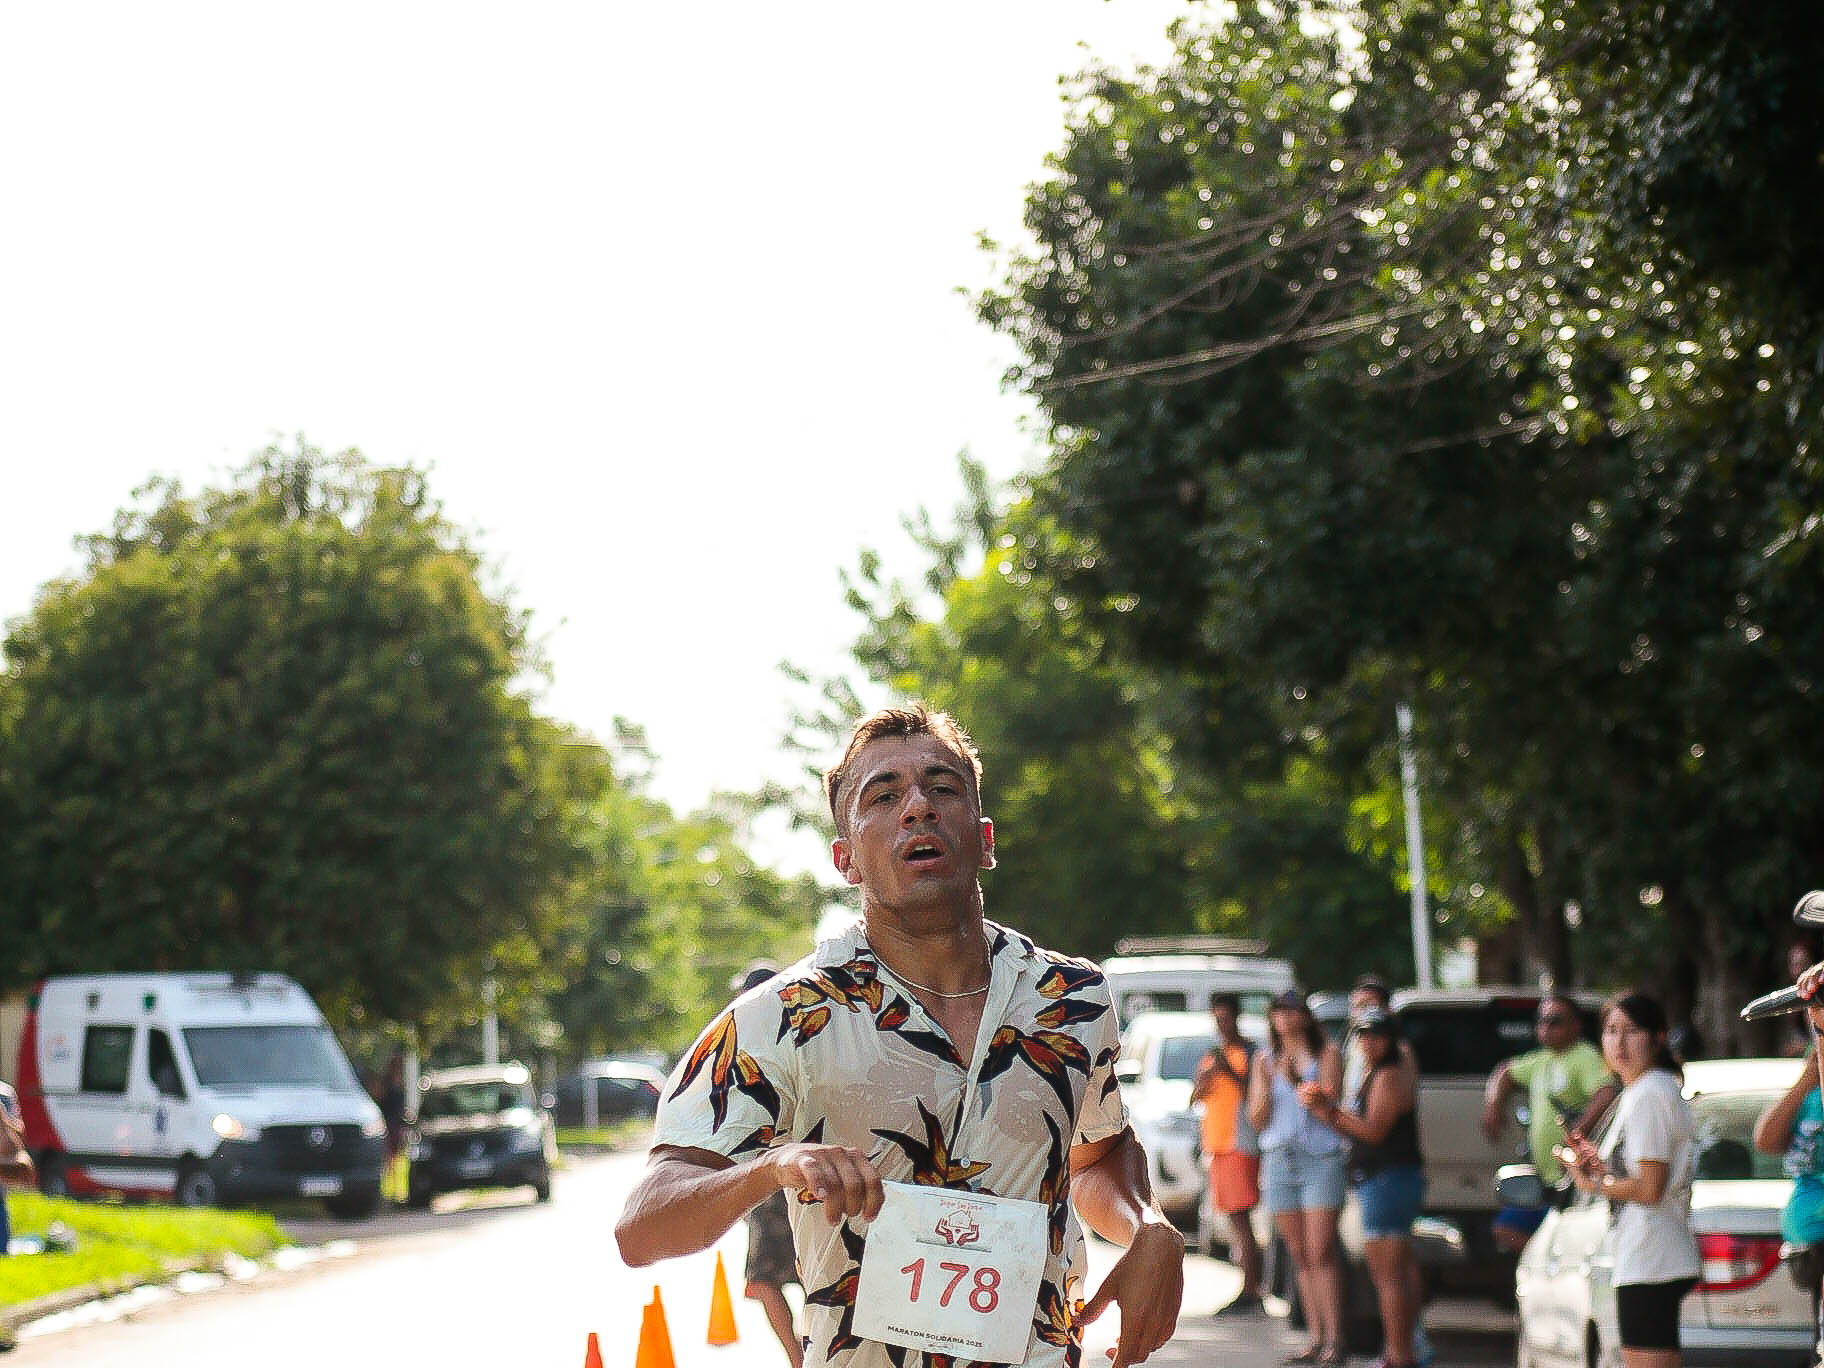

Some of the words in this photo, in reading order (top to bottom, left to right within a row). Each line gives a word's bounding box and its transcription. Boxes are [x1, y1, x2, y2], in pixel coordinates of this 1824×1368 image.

[900, 1257, 1001, 1314] 178
[887, 1326, 925, 1338] MARATON
[926, 1333, 964, 1345] SOLIDARIA
